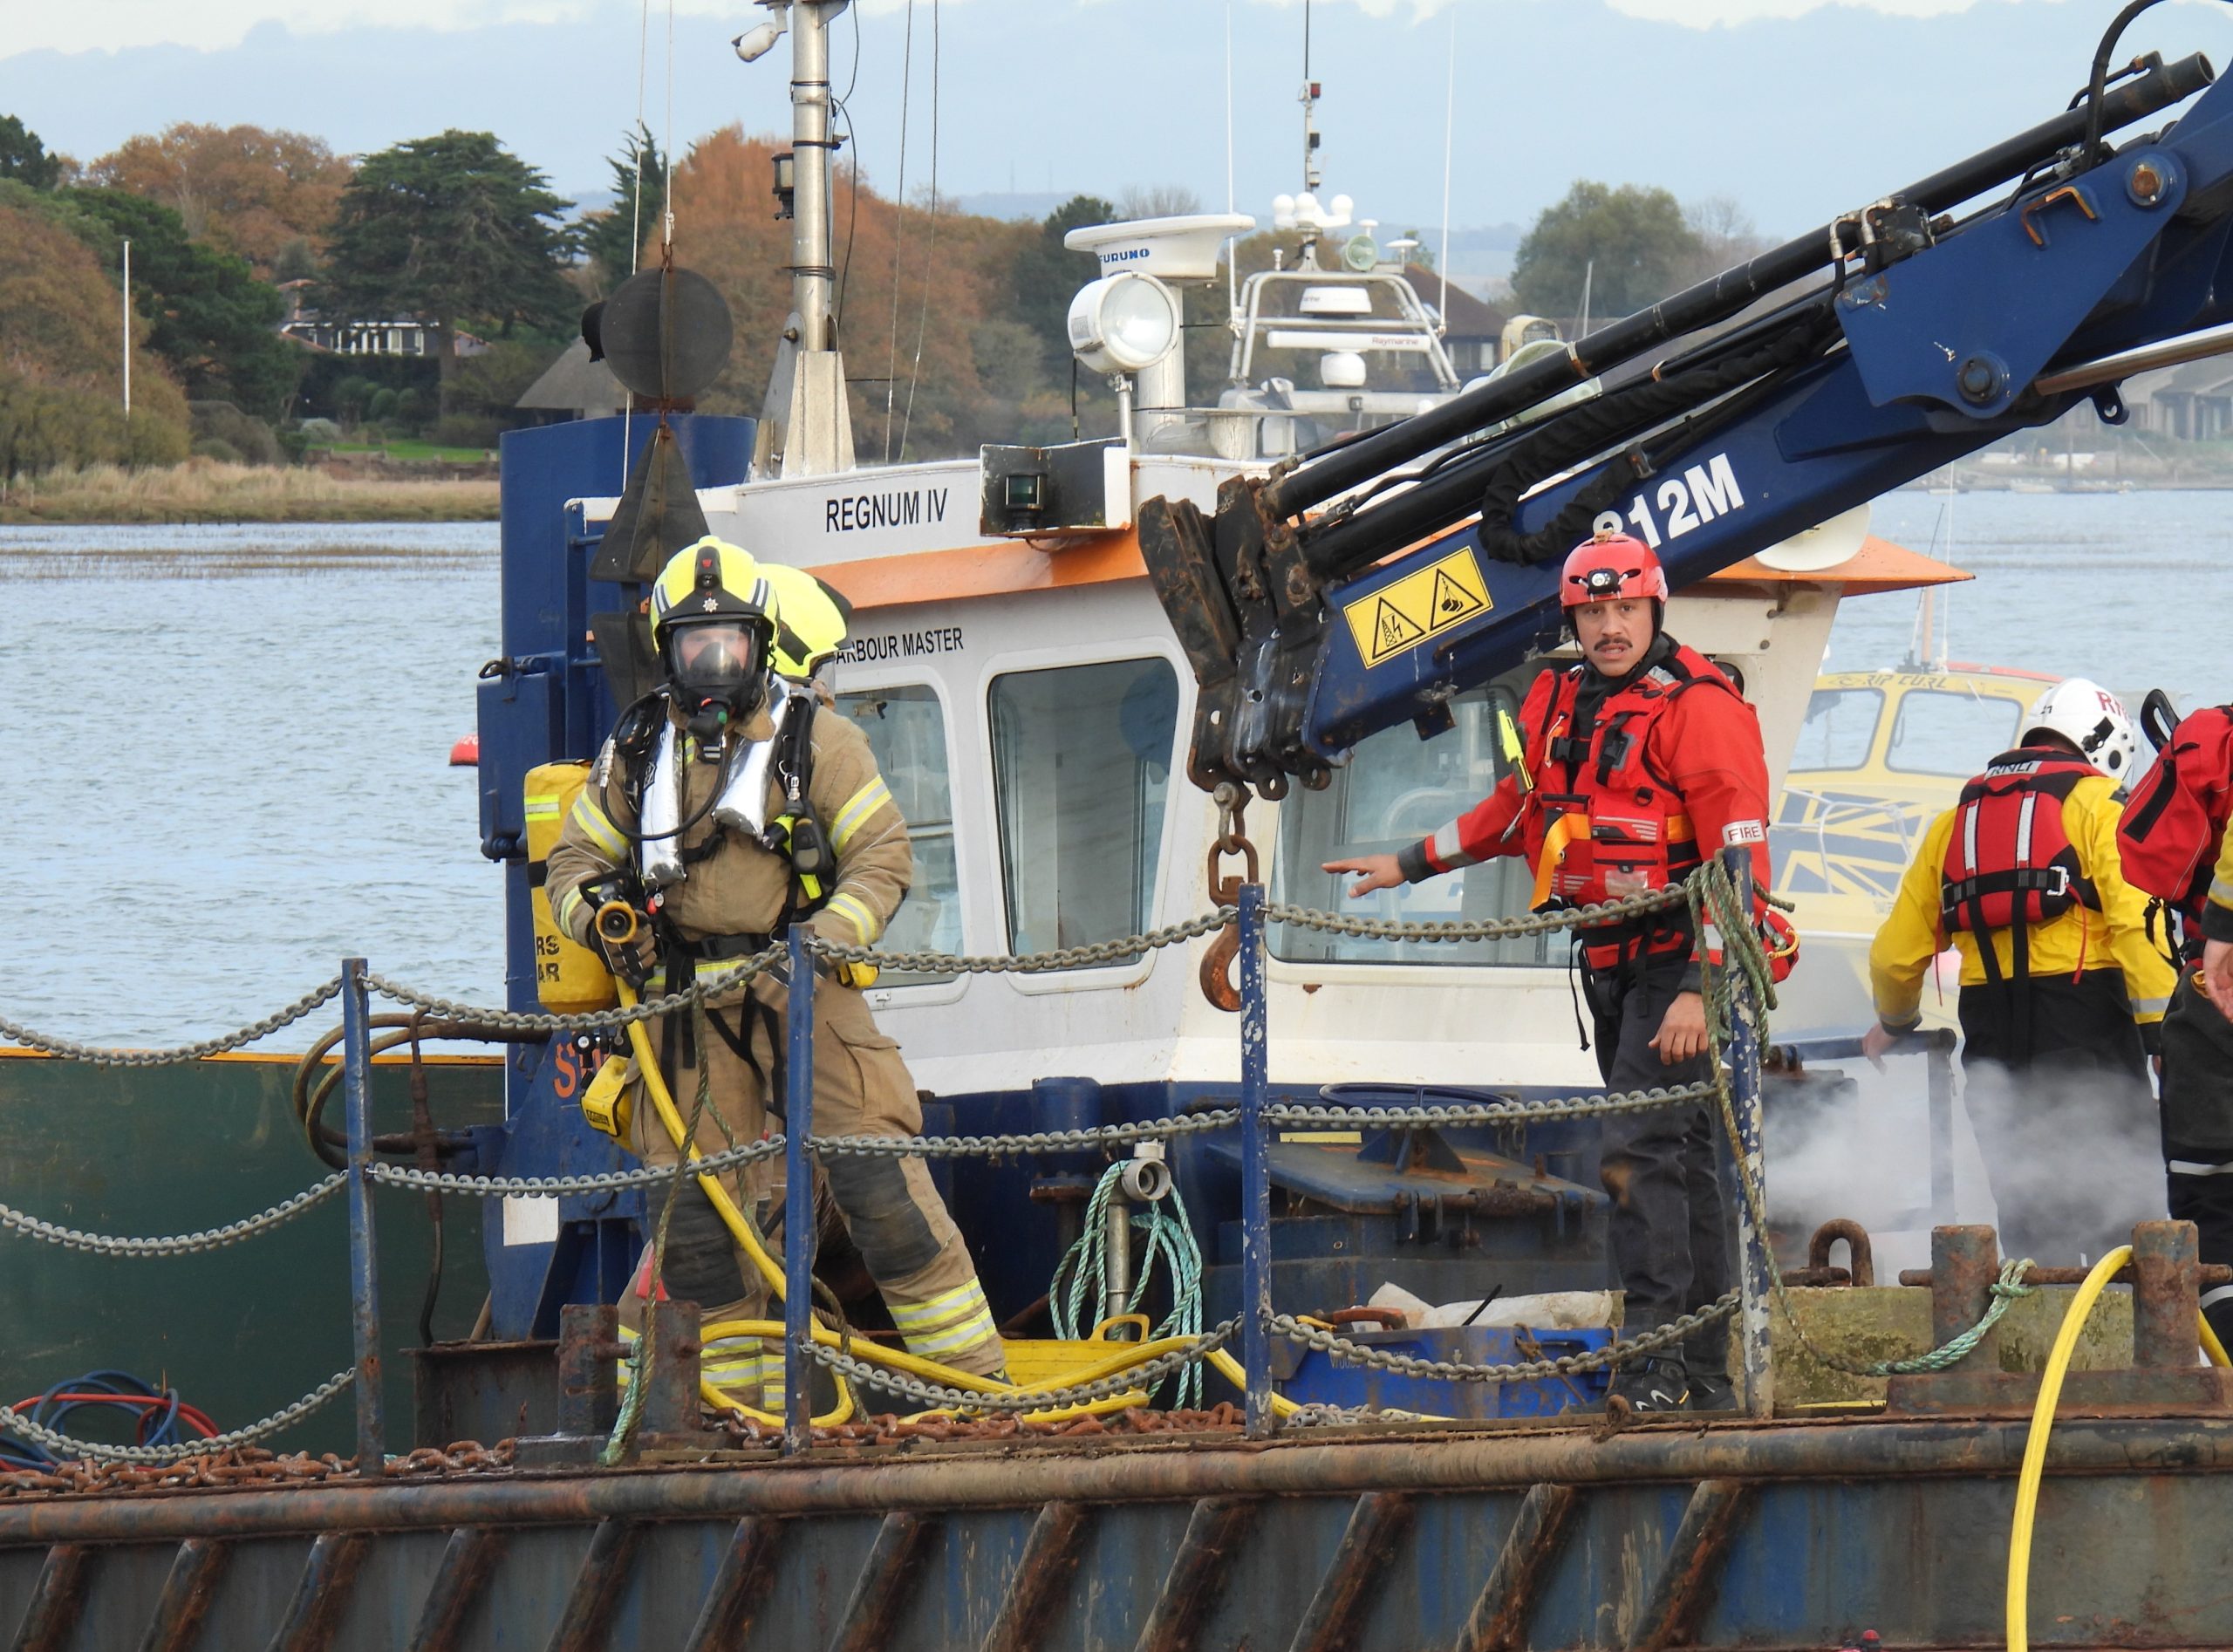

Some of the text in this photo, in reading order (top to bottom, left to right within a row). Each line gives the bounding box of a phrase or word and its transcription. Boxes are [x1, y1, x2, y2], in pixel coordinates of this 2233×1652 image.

[826, 488, 947, 532] REGNUM IV
[836, 627, 964, 665] ARBOUR MASTER
[1863, 674, 1947, 690] RIP CURL
[1728, 826, 1760, 842] FIRE
